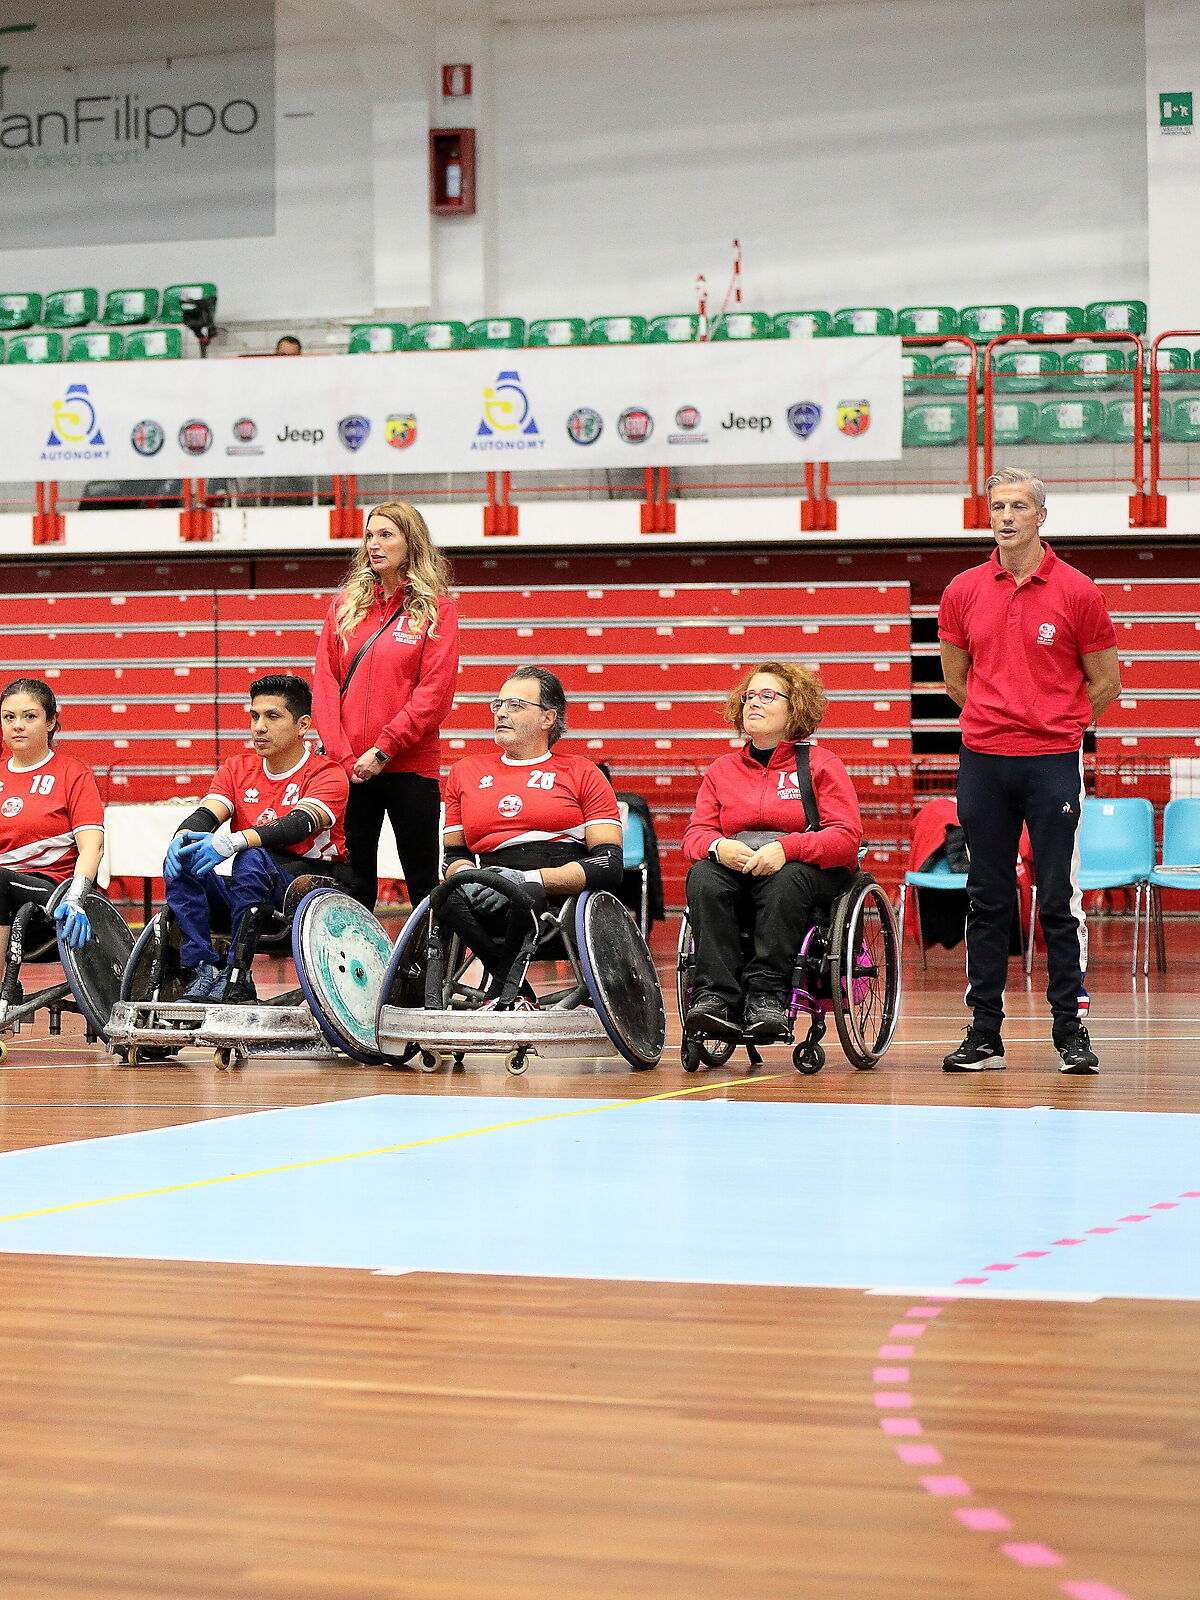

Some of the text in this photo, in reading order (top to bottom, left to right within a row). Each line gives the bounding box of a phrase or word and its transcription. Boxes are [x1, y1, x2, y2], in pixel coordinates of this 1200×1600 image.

[721, 411, 772, 433] Jeep
[277, 425, 324, 446] Jeep
[470, 439, 546, 451] AUTONOMY
[40, 450, 110, 461] AUTONOMY
[394, 615, 408, 631] I
[29, 774, 56, 795] 19
[527, 770, 557, 790] 26
[777, 771, 788, 789] I
